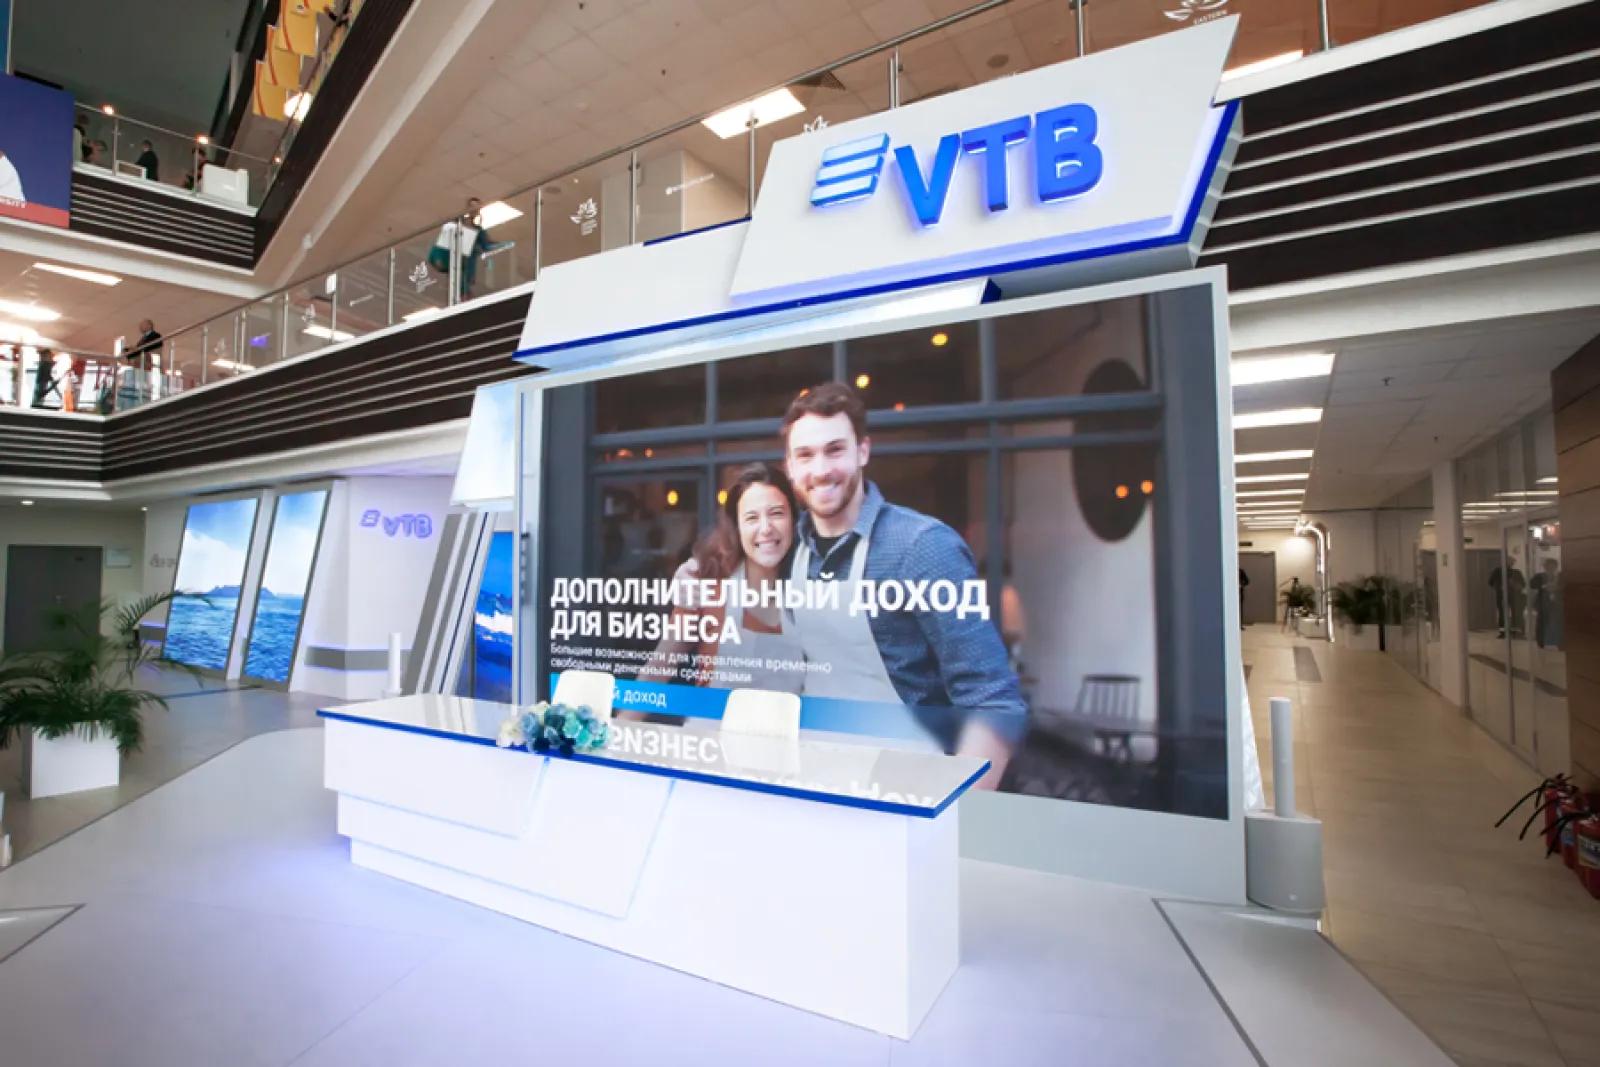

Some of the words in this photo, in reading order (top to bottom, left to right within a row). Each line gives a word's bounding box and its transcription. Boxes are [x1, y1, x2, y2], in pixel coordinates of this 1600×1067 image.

[893, 102, 1104, 228] VTB
[382, 513, 433, 539] VTB
[550, 572, 840, 610] ДОПОЛНИТЕЛЬНЫЙ
[848, 579, 991, 620] ДОХОД
[550, 609, 602, 640] ДЛЯ
[608, 611, 742, 645] БИЗНЕСА
[550, 643, 593, 657] Большие
[595, 647, 666, 662] возможности
[668, 653, 689, 665] для
[691, 653, 763, 670] управления
[765, 658, 833, 675] временно
[550, 657, 612, 672] свободными
[613, 663, 678, 677] денежными
[680, 667, 752, 683] средствами
[623, 689, 668, 709] доход
